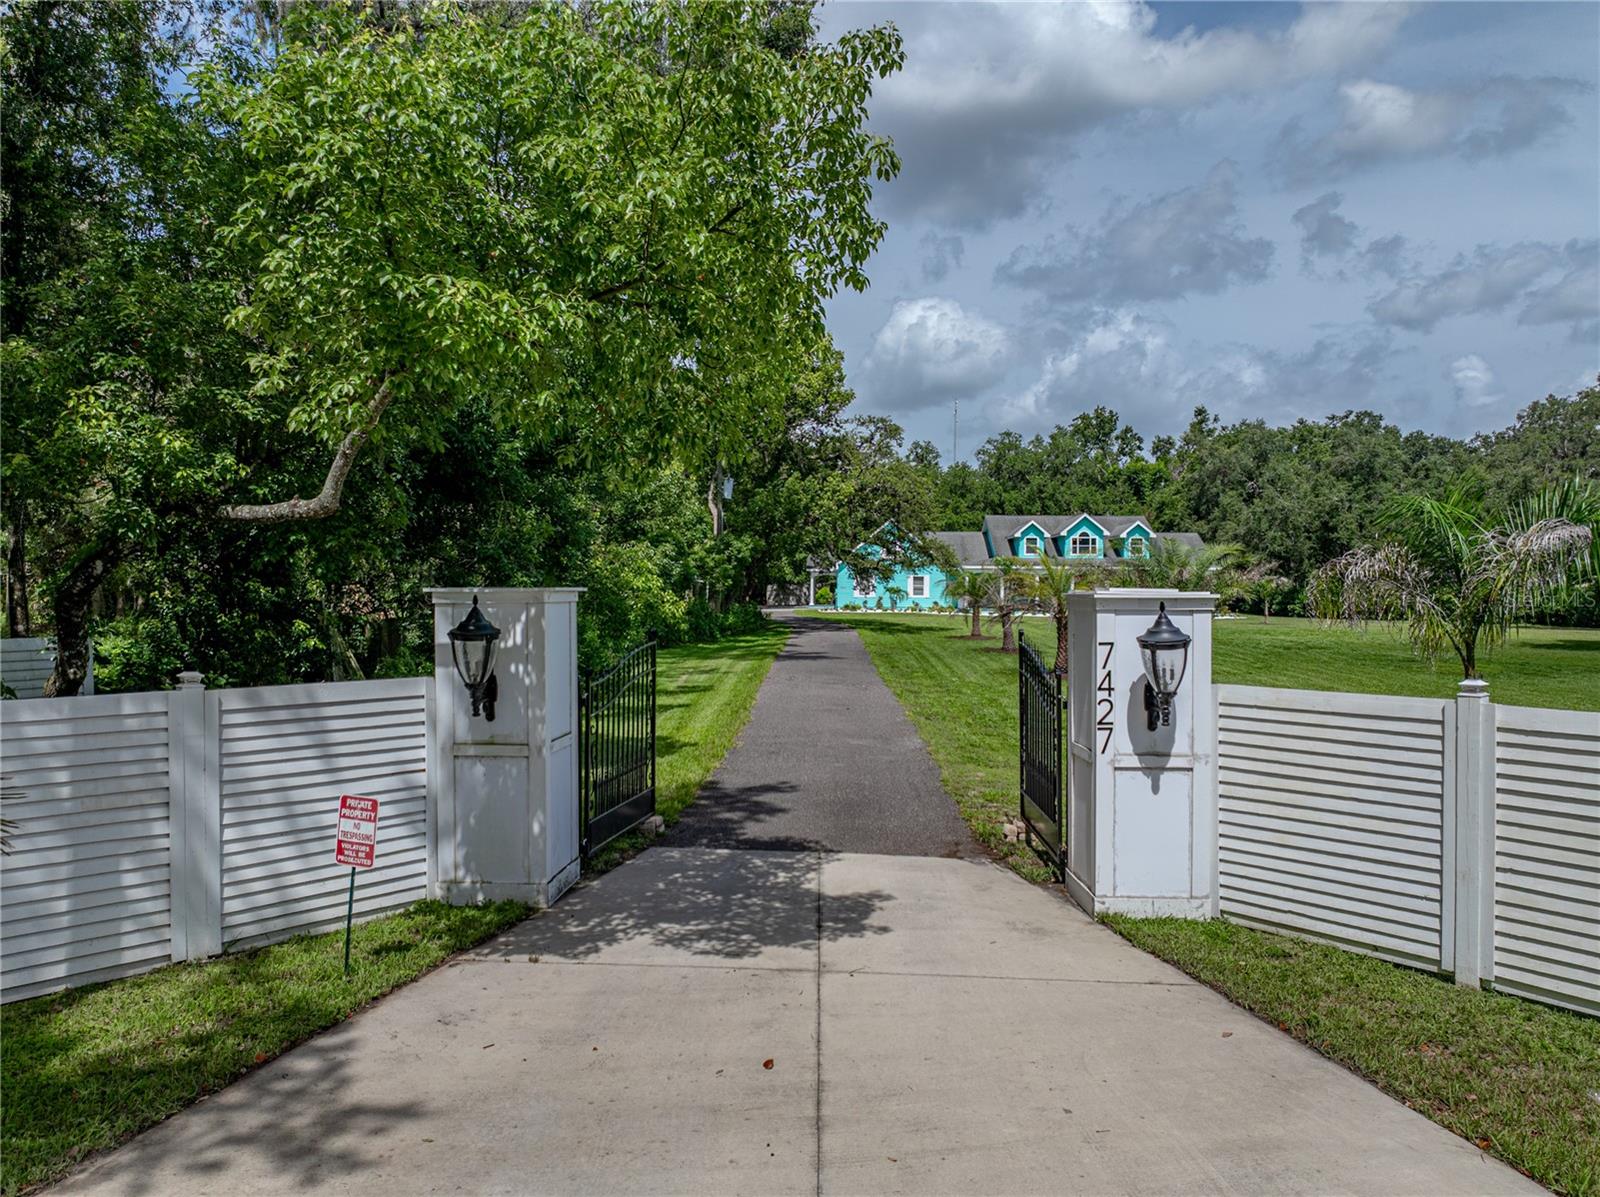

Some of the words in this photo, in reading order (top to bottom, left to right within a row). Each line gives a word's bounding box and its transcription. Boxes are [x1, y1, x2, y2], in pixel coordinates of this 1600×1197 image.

[1097, 642, 1115, 755] 7427
[346, 798, 372, 810] PRIVATE
[341, 808, 376, 821] PROPERTY
[352, 822, 361, 831] NO
[340, 830, 373, 843] TRESPASSING
[342, 843, 370, 852] VIOLATORS
